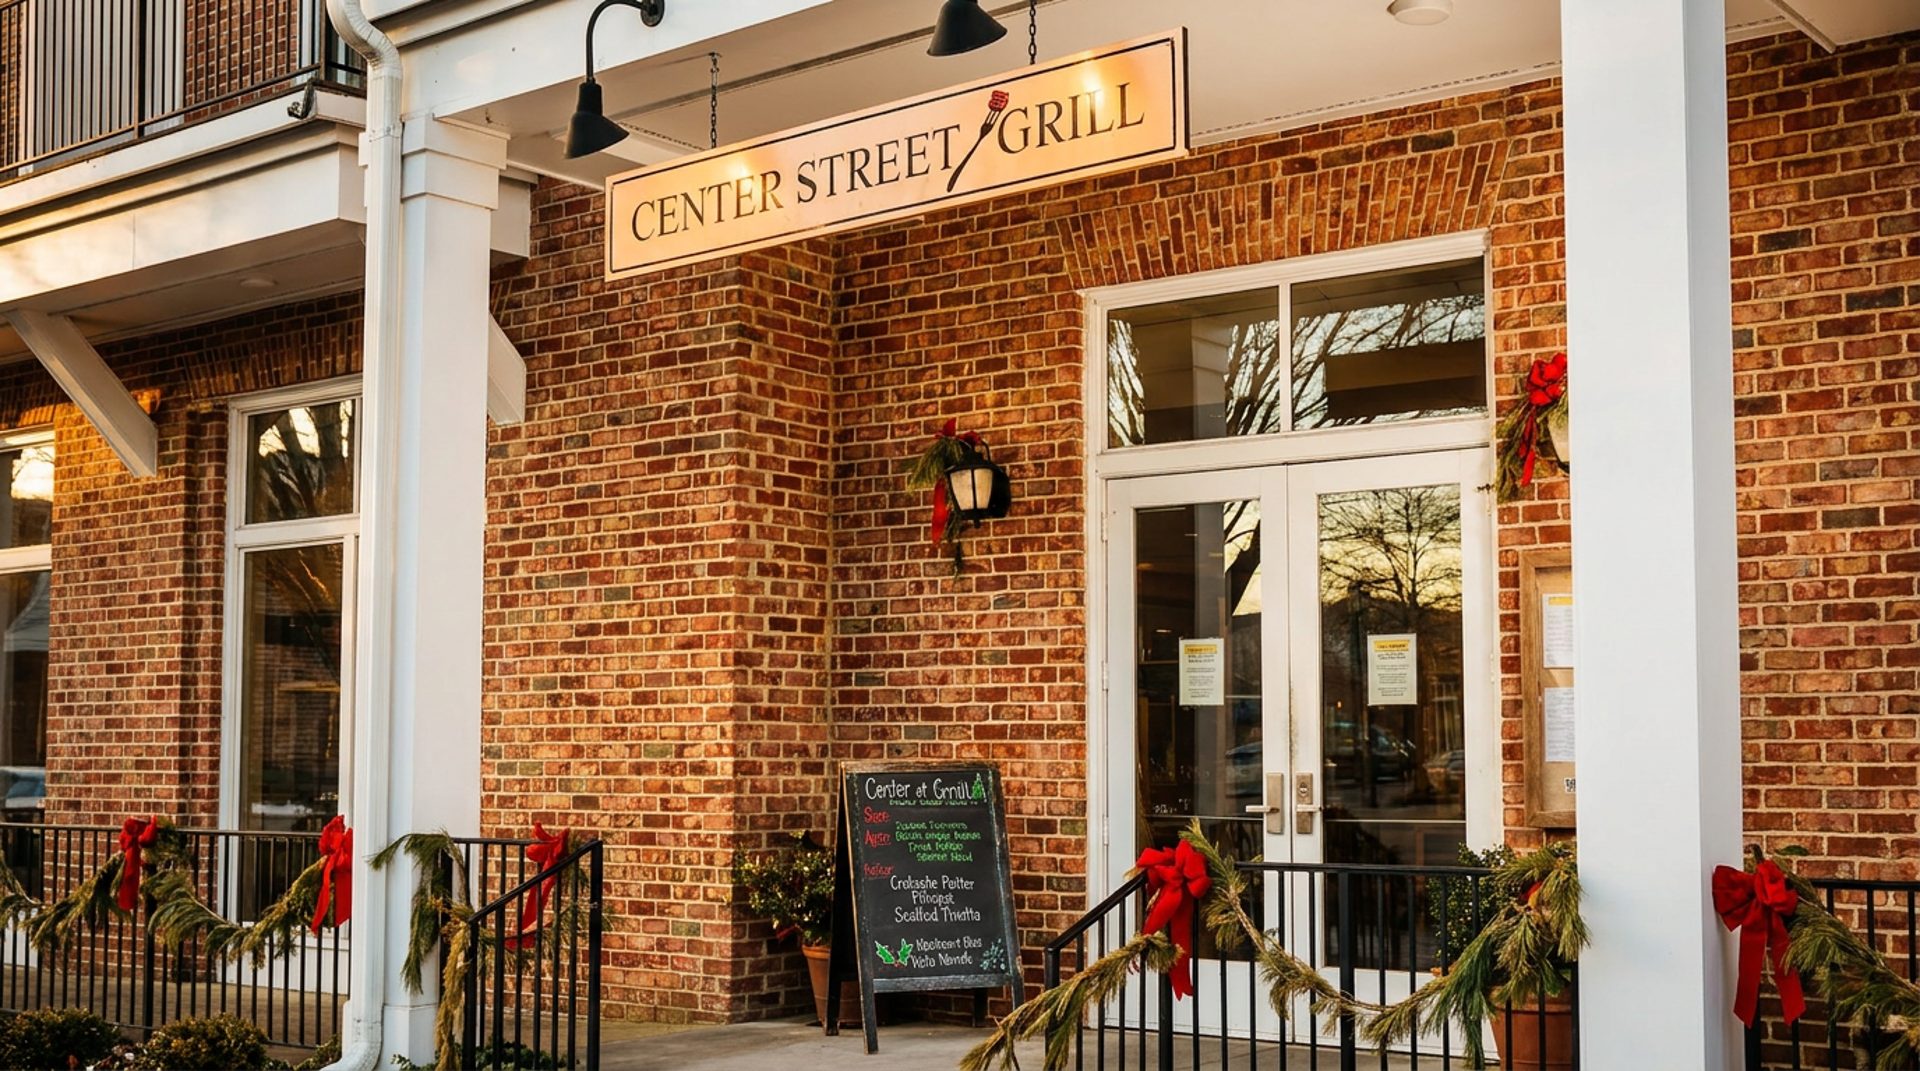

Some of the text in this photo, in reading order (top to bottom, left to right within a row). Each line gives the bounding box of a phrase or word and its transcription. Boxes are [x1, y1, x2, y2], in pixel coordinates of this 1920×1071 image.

[631, 81, 1146, 242] CENTER STREET GRILL
[865, 777, 911, 800] Center
